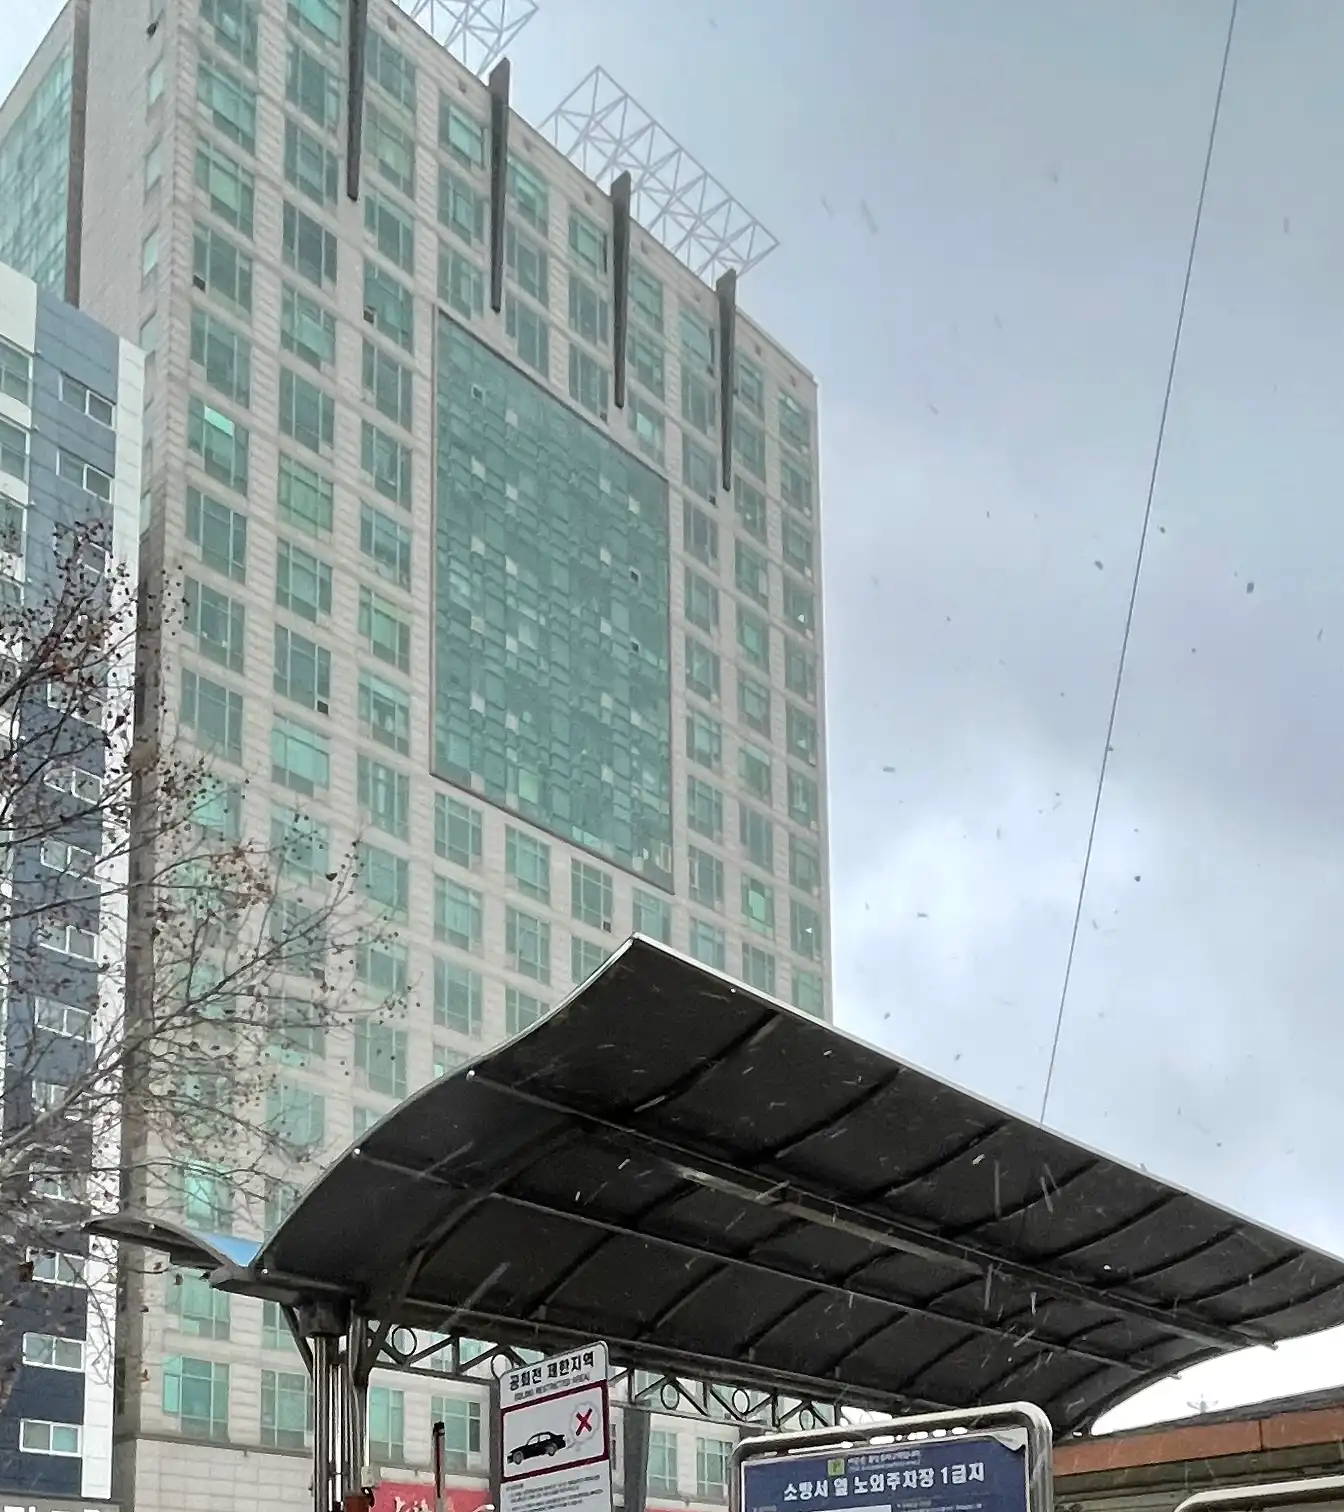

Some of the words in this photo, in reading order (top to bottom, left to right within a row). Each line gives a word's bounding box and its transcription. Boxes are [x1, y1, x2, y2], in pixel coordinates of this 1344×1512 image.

[547, 1351, 594, 1378] 제한지역
[854, 1467, 934, 1495] 노외주차장
[940, 1462, 985, 1485] 1급지
